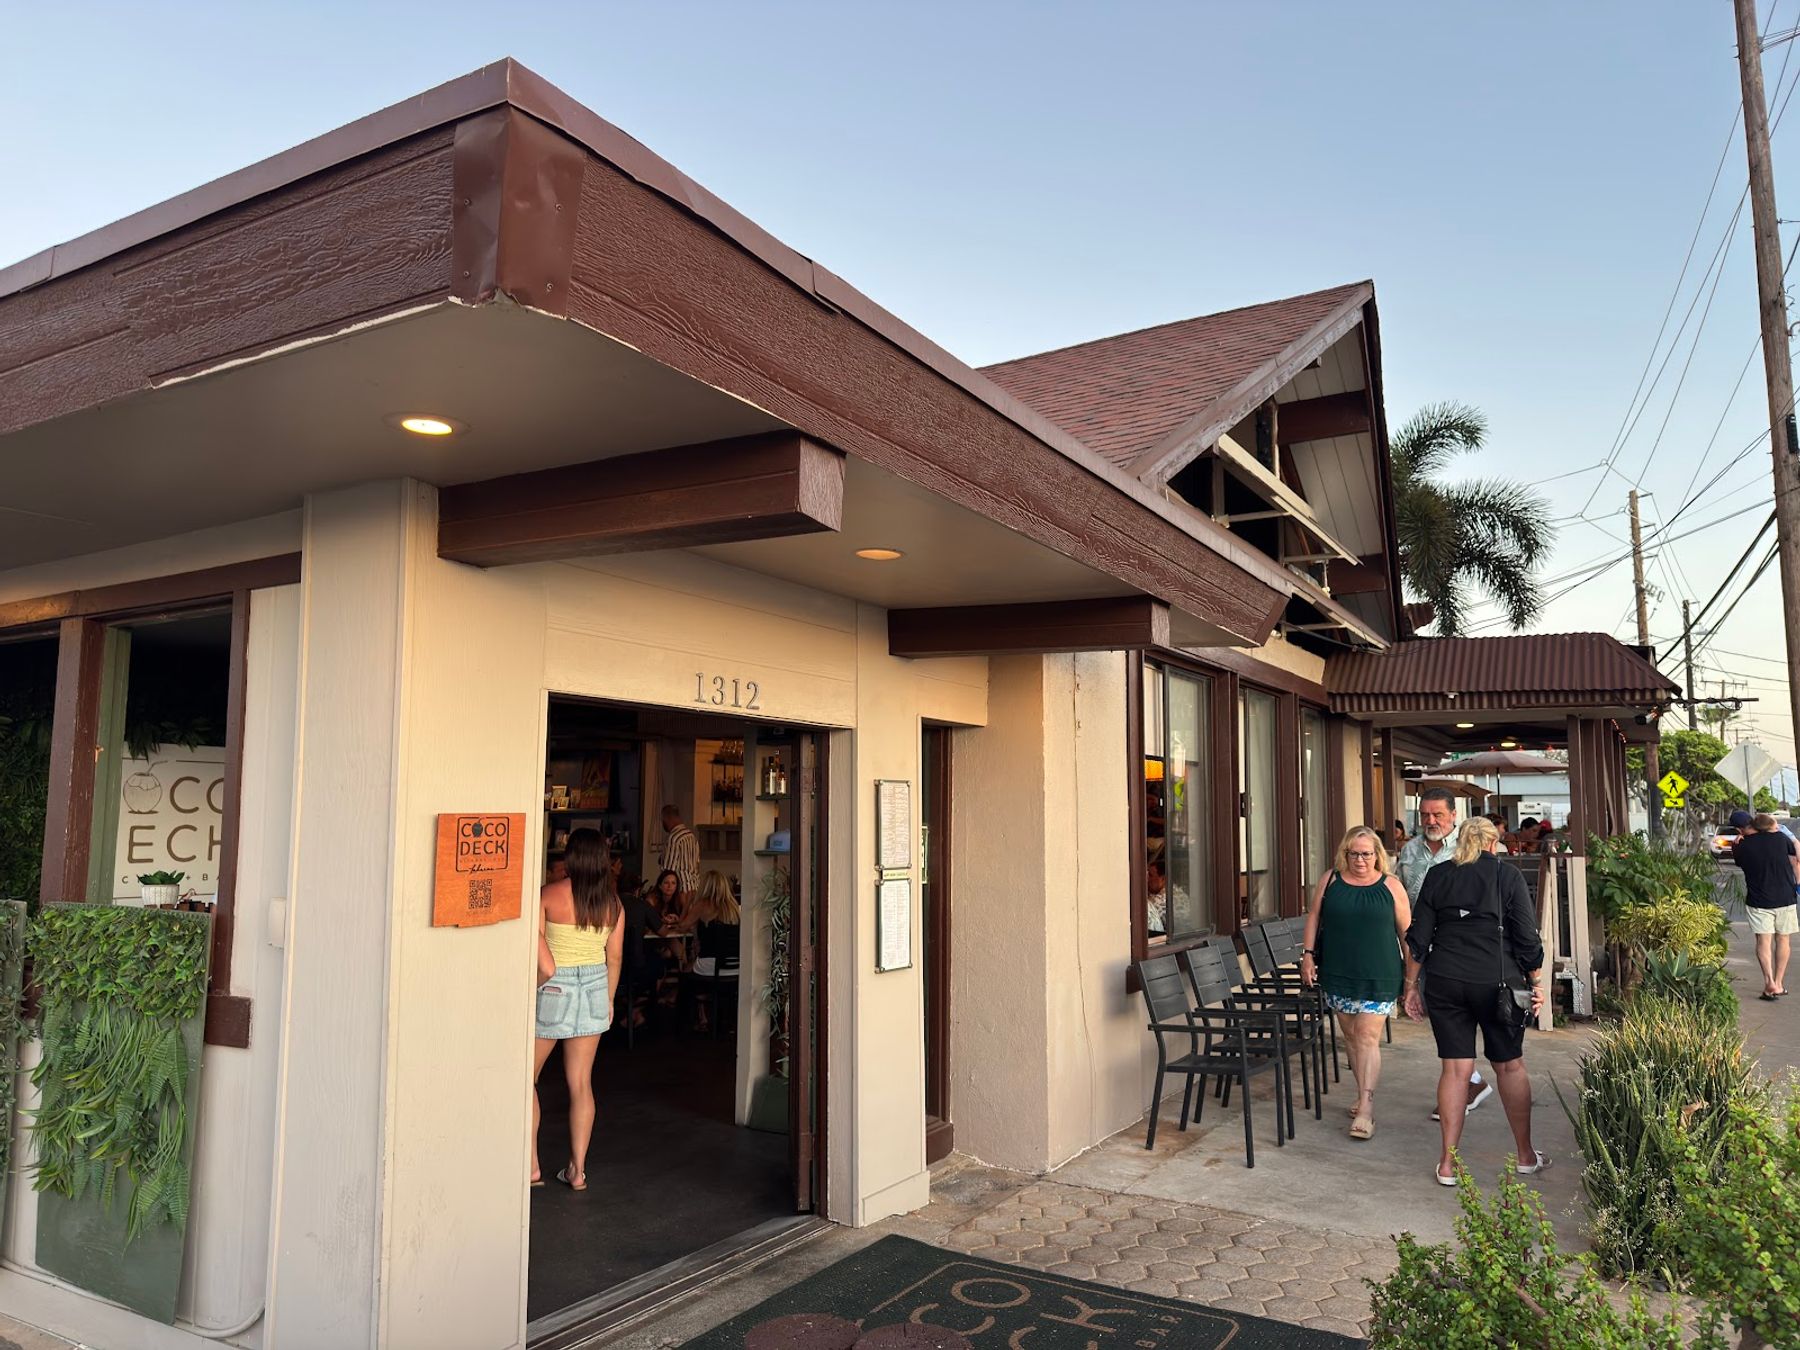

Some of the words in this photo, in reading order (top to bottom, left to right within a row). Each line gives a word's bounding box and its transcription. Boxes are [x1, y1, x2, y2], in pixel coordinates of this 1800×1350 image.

[694, 672, 760, 710] 1312
[461, 822, 507, 837] COCO
[460, 840, 505, 856] DECK
